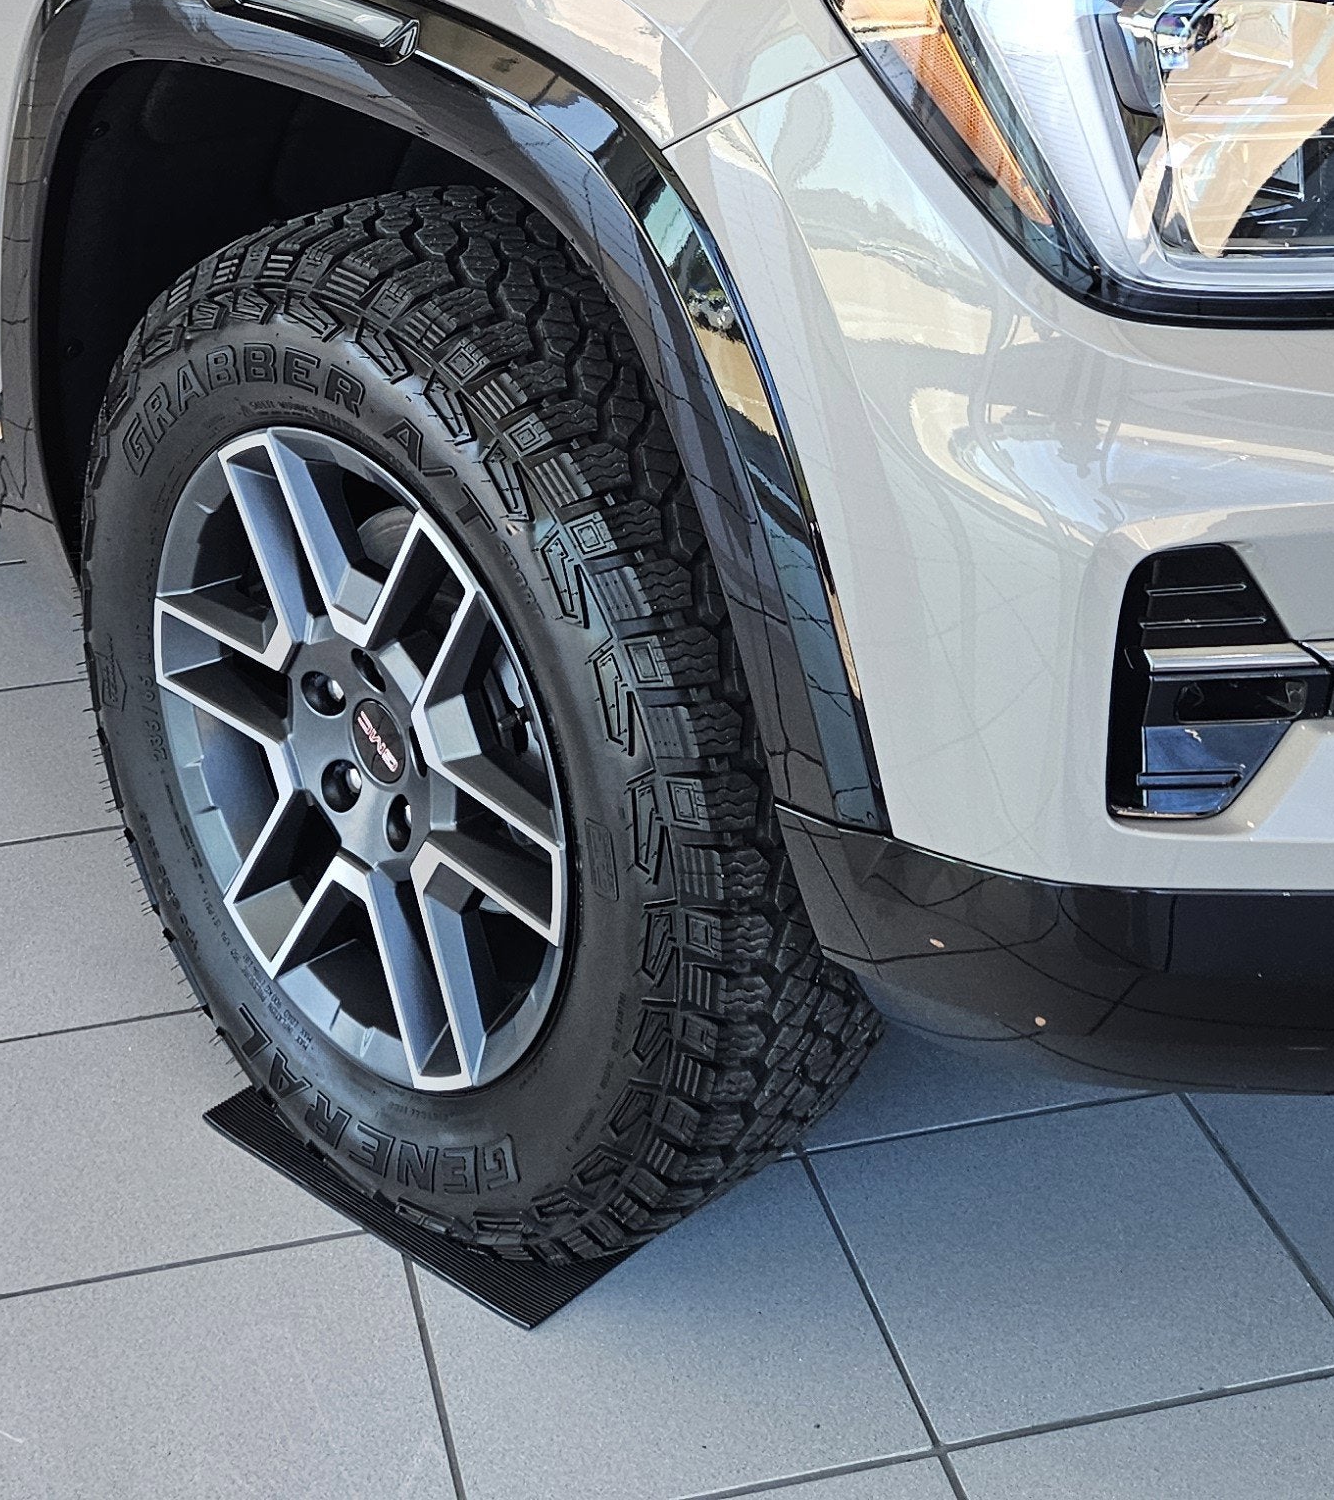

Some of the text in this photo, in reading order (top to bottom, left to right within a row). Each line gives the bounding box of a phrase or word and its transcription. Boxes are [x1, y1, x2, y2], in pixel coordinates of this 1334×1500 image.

[122, 342, 366, 478] GRABBER
[357, 711, 398, 773] GMC
[238, 1003, 521, 1197] GENERAL
